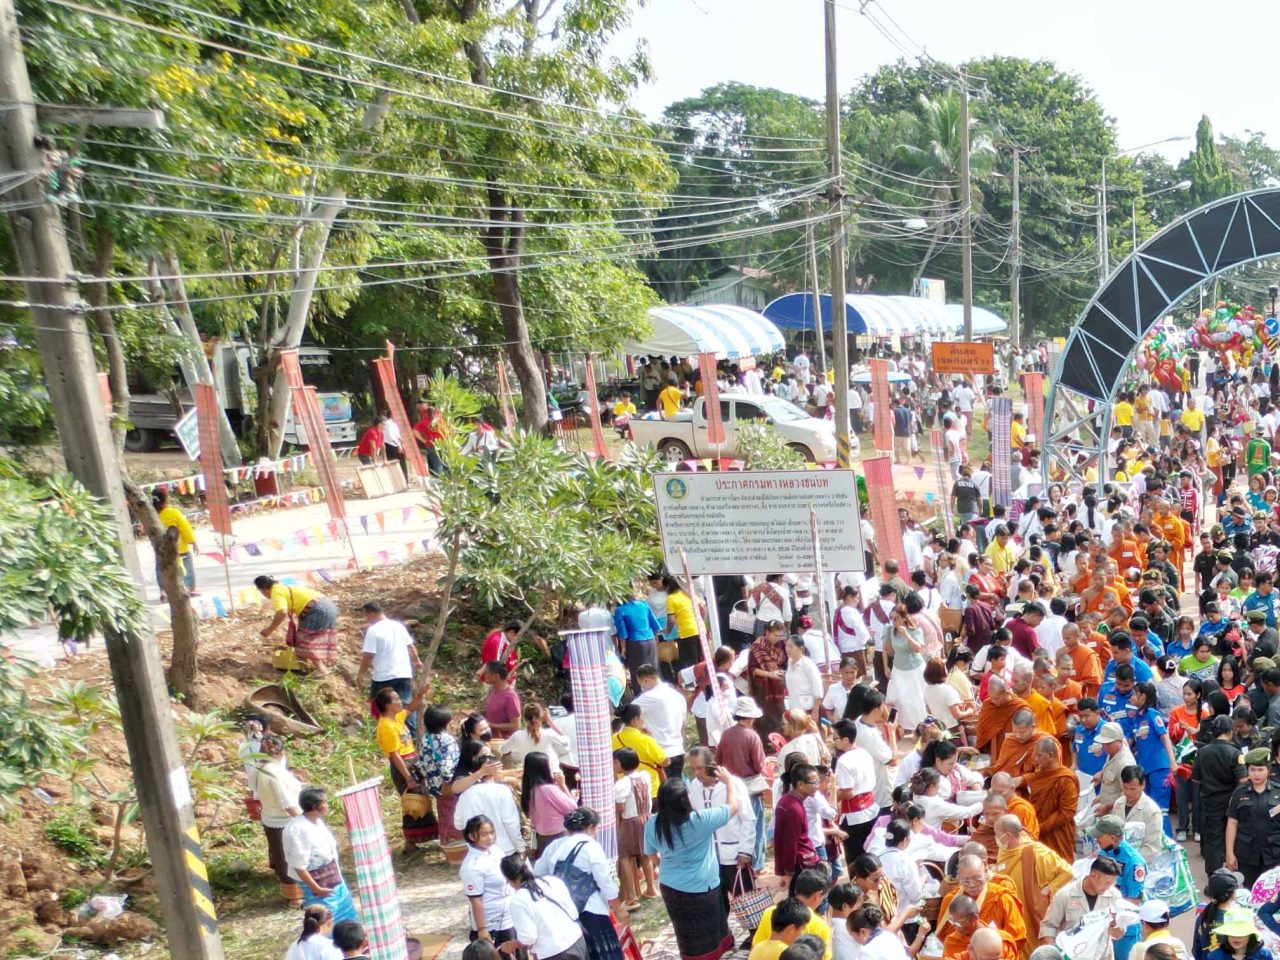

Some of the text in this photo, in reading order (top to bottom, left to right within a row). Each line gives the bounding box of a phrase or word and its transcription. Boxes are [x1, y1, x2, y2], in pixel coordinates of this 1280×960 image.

[714, 475, 829, 491] ประกาศกรมทางหลวงชนบท
